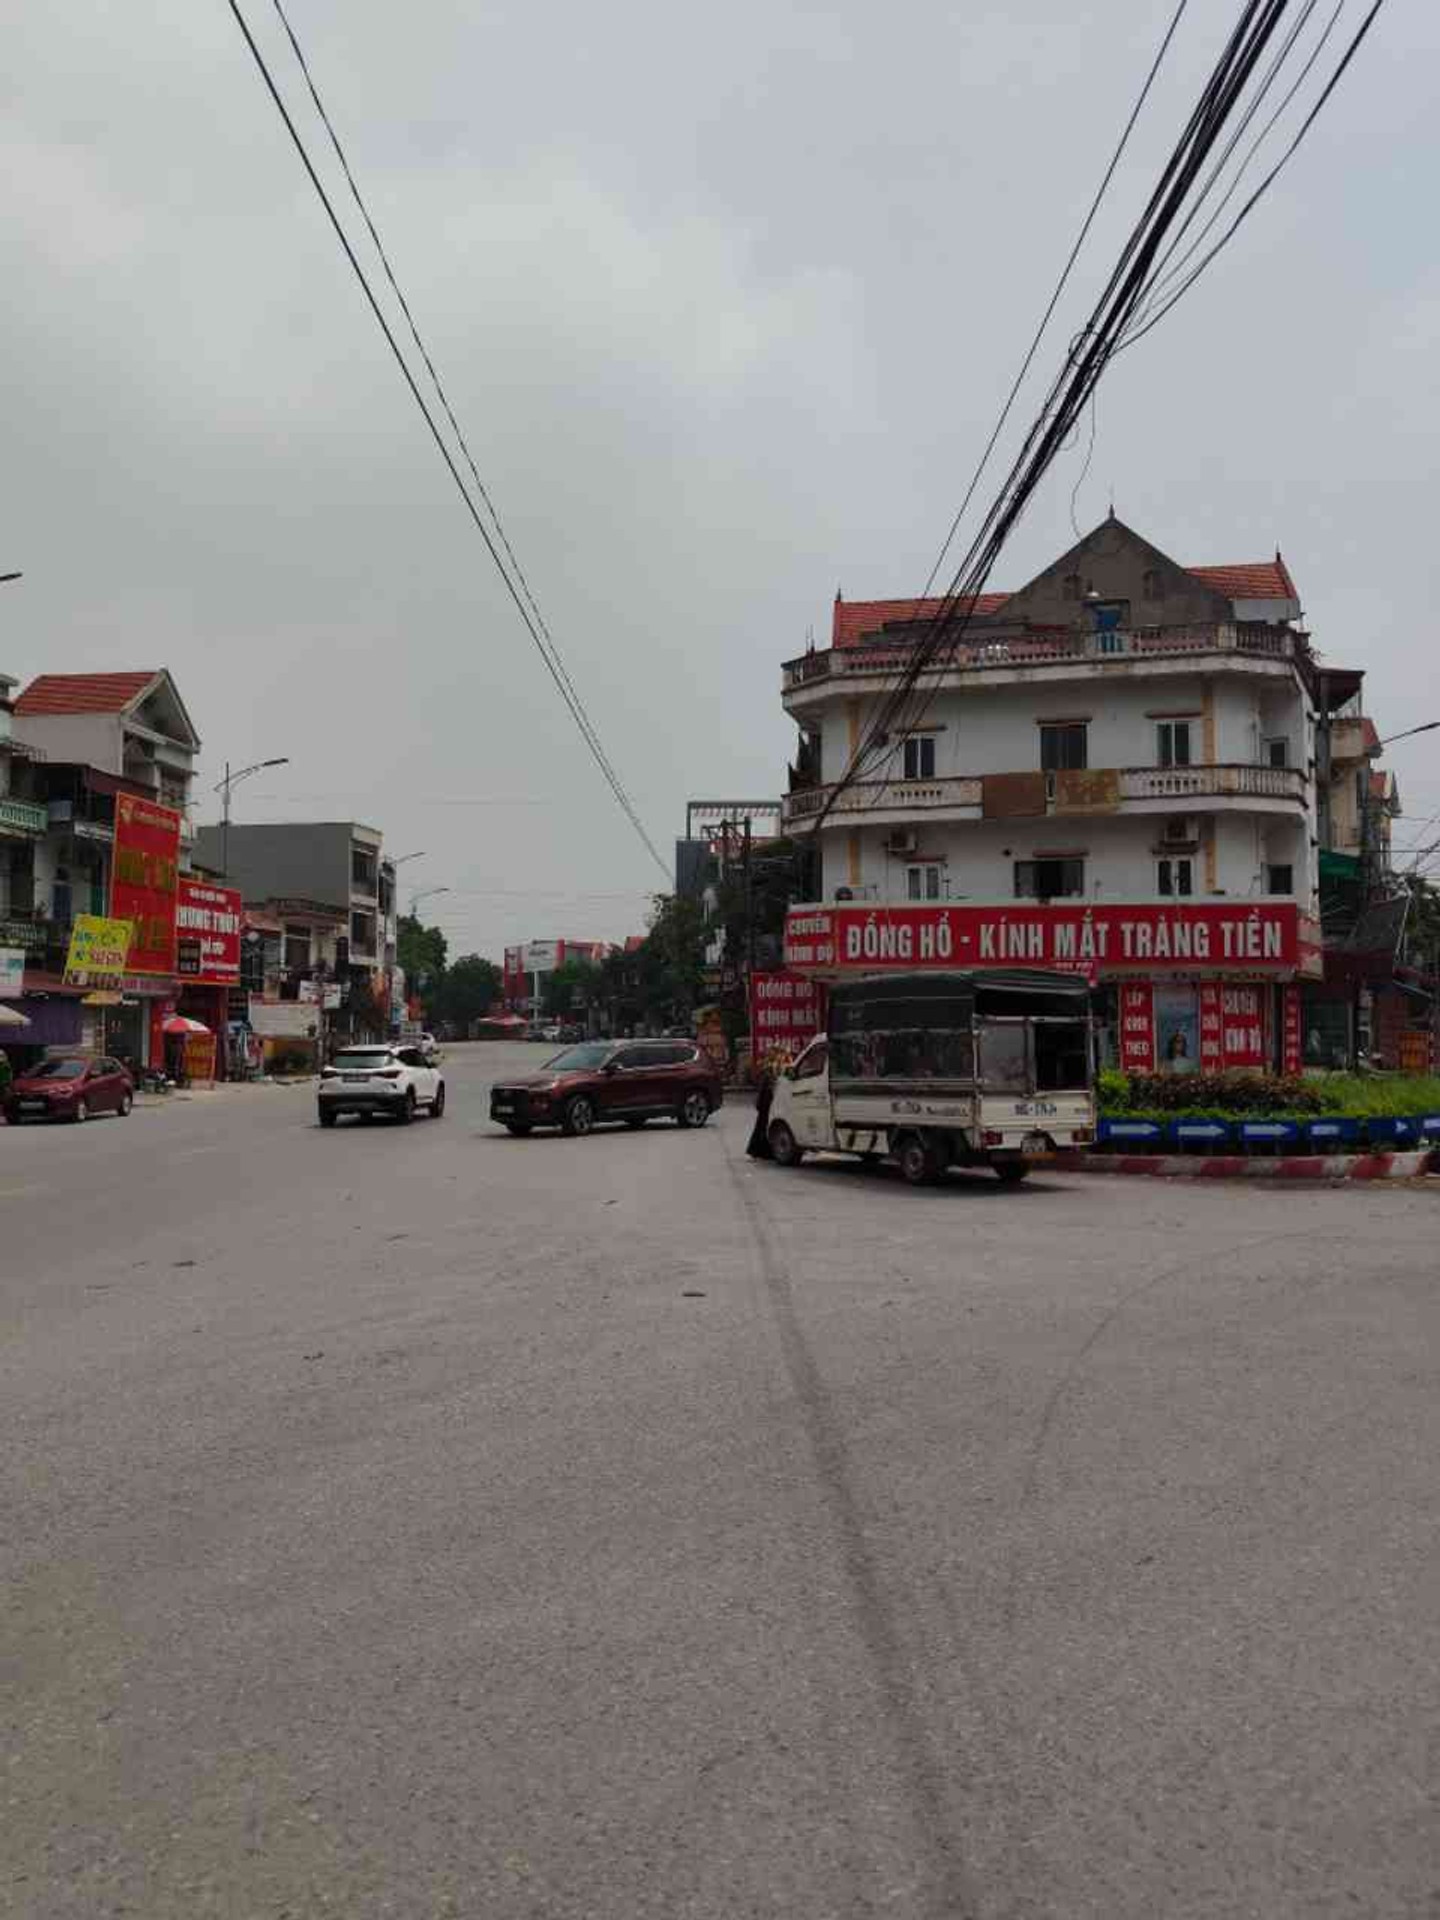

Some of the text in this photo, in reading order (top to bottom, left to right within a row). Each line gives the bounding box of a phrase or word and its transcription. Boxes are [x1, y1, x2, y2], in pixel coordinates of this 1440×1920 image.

[979, 915, 1045, 959] KÍNH
[1053, 908, 1109, 957] MẮT
[1220, 907, 1282, 957] TIỀN
